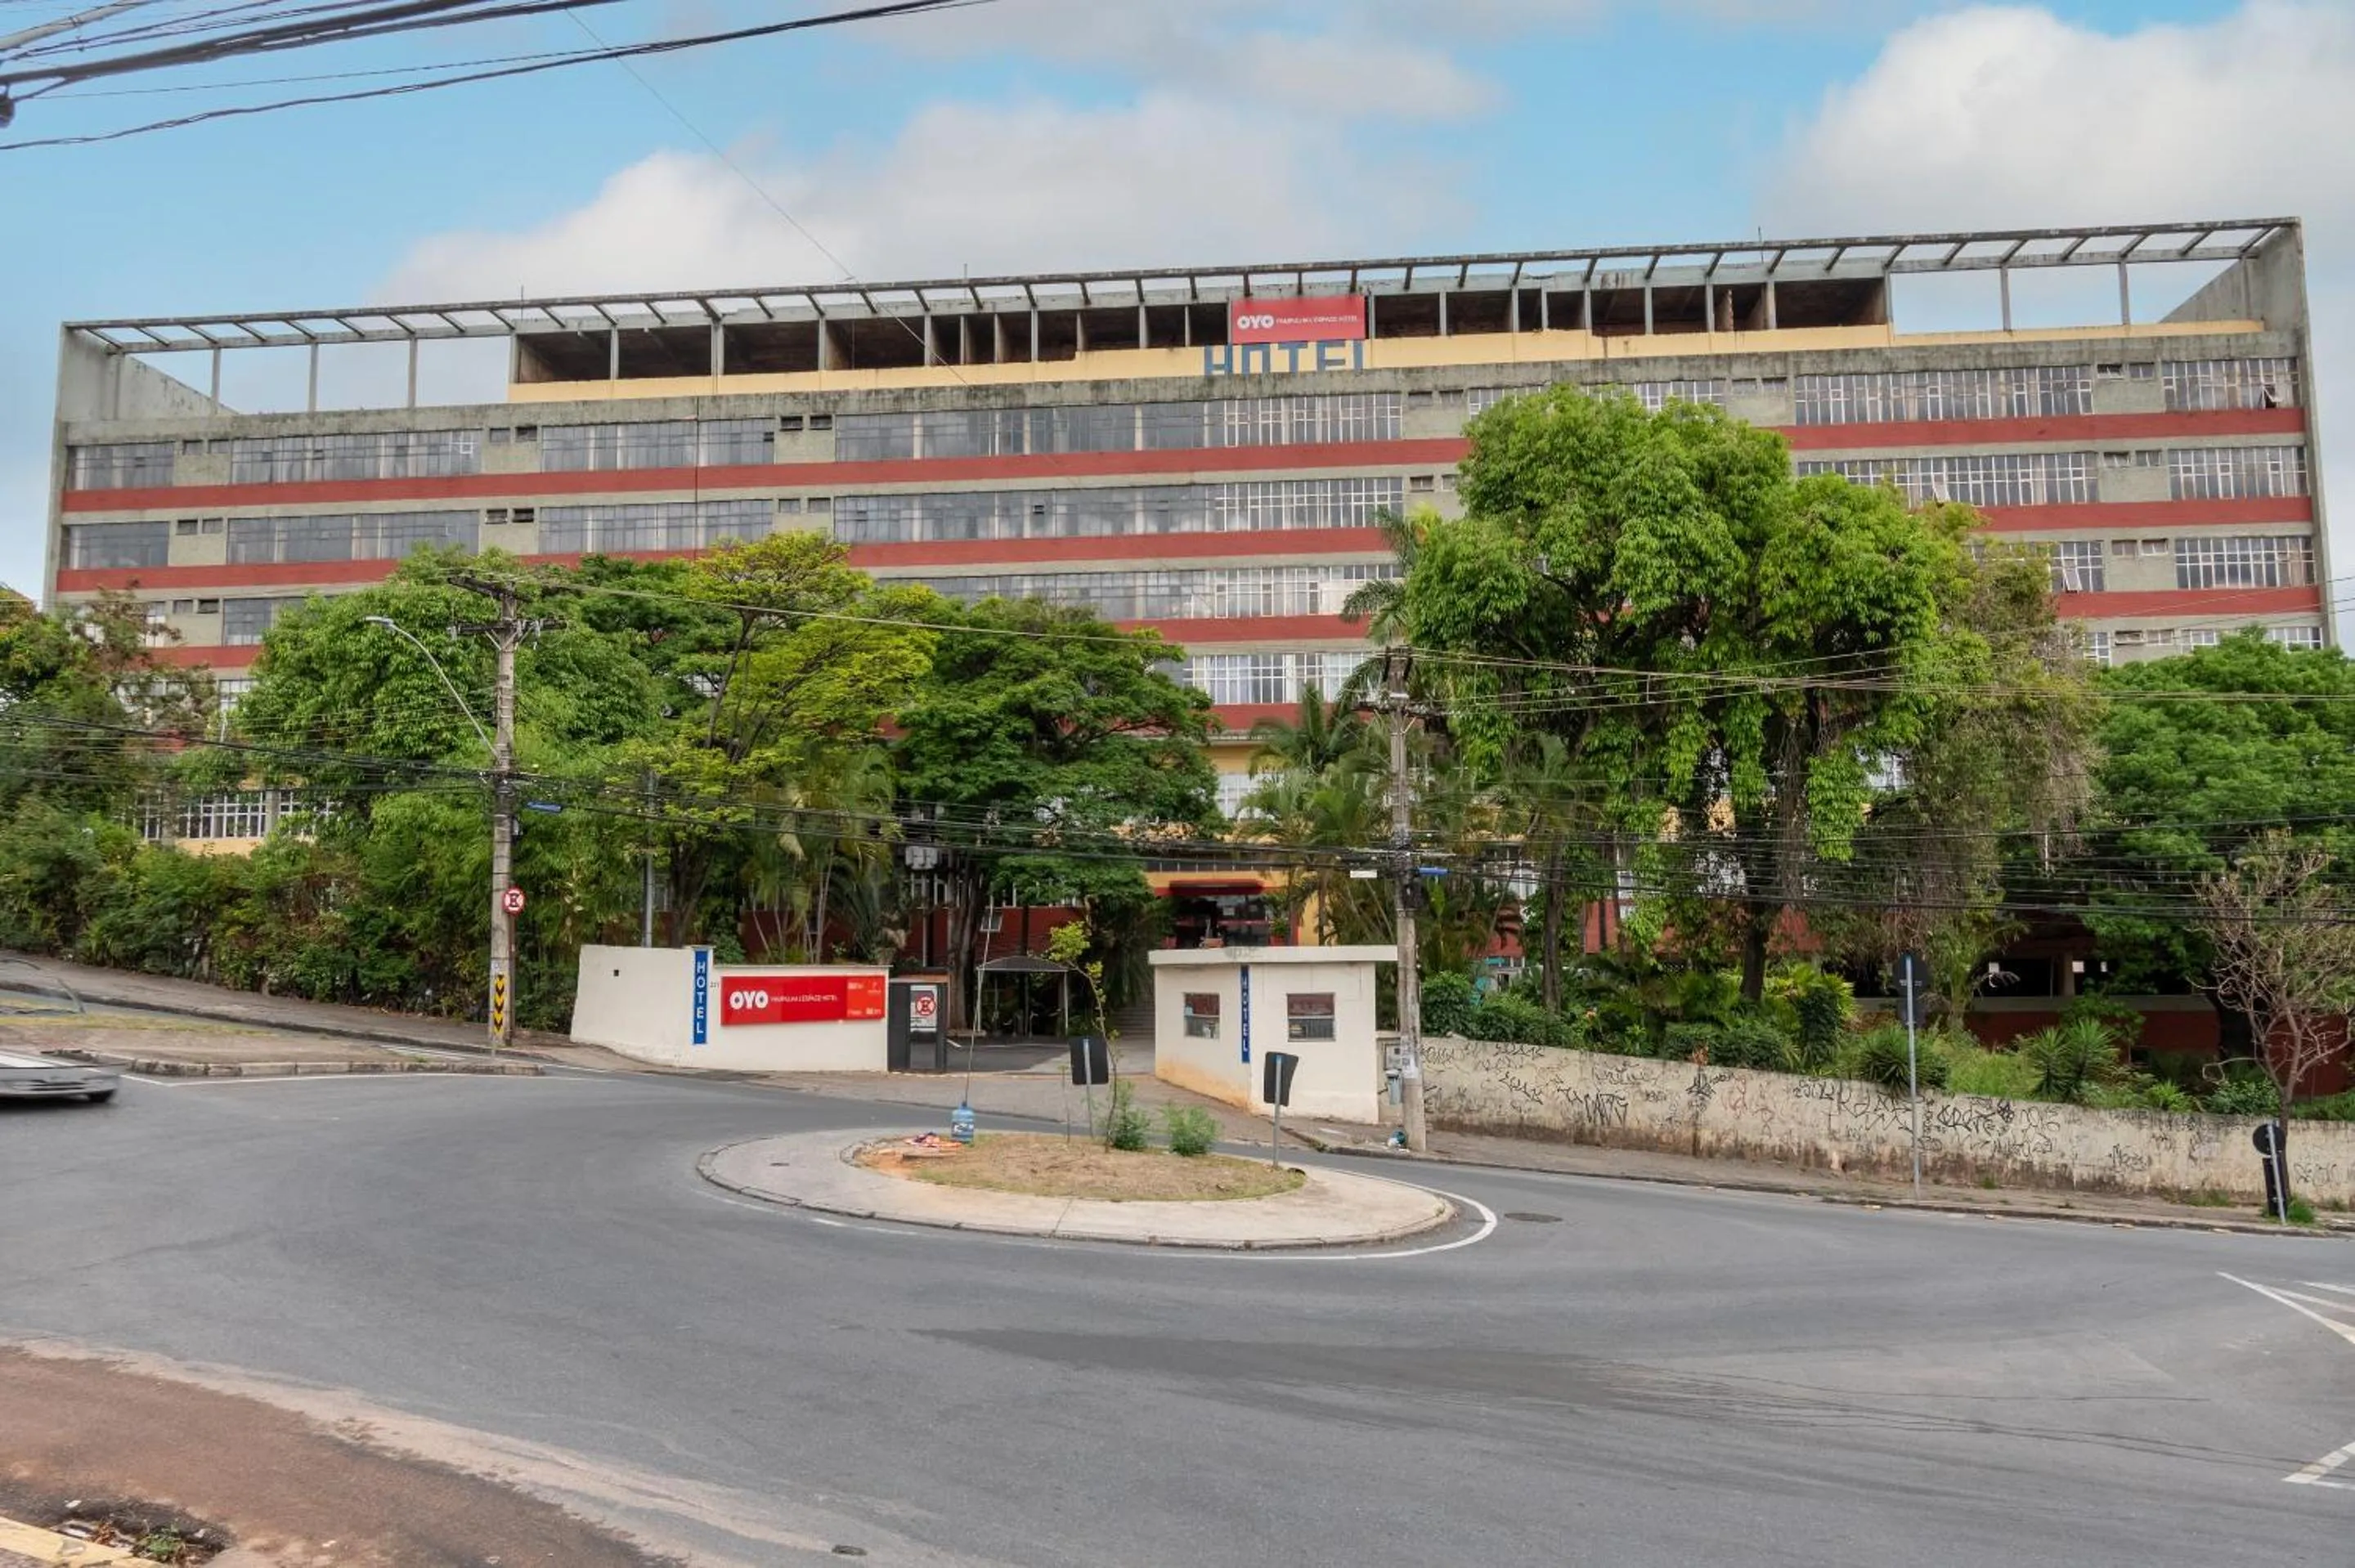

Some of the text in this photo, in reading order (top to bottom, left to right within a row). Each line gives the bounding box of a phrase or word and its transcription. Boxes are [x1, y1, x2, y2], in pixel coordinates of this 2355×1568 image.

[1237, 314, 1274, 329] OYO
[696, 961, 706, 1034] HOTEL
[729, 990, 769, 1010] OYO
